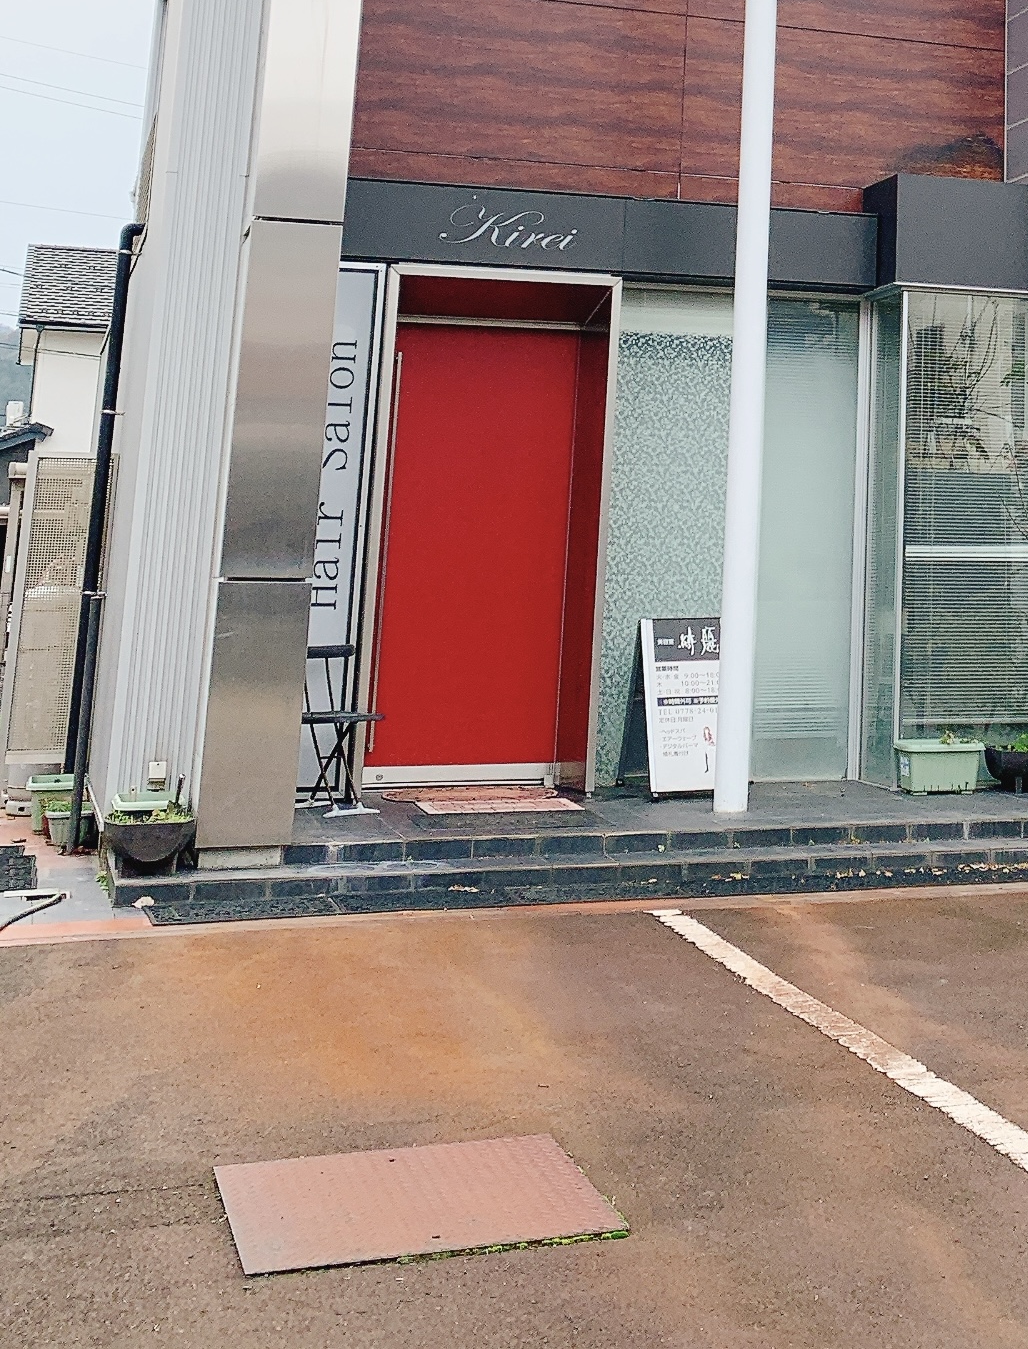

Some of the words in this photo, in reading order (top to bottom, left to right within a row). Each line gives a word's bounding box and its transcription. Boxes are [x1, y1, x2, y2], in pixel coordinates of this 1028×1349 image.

[439, 195, 577, 250] Kirei
[322, 339, 357, 470] Salon
[311, 502, 343, 610] Hair
